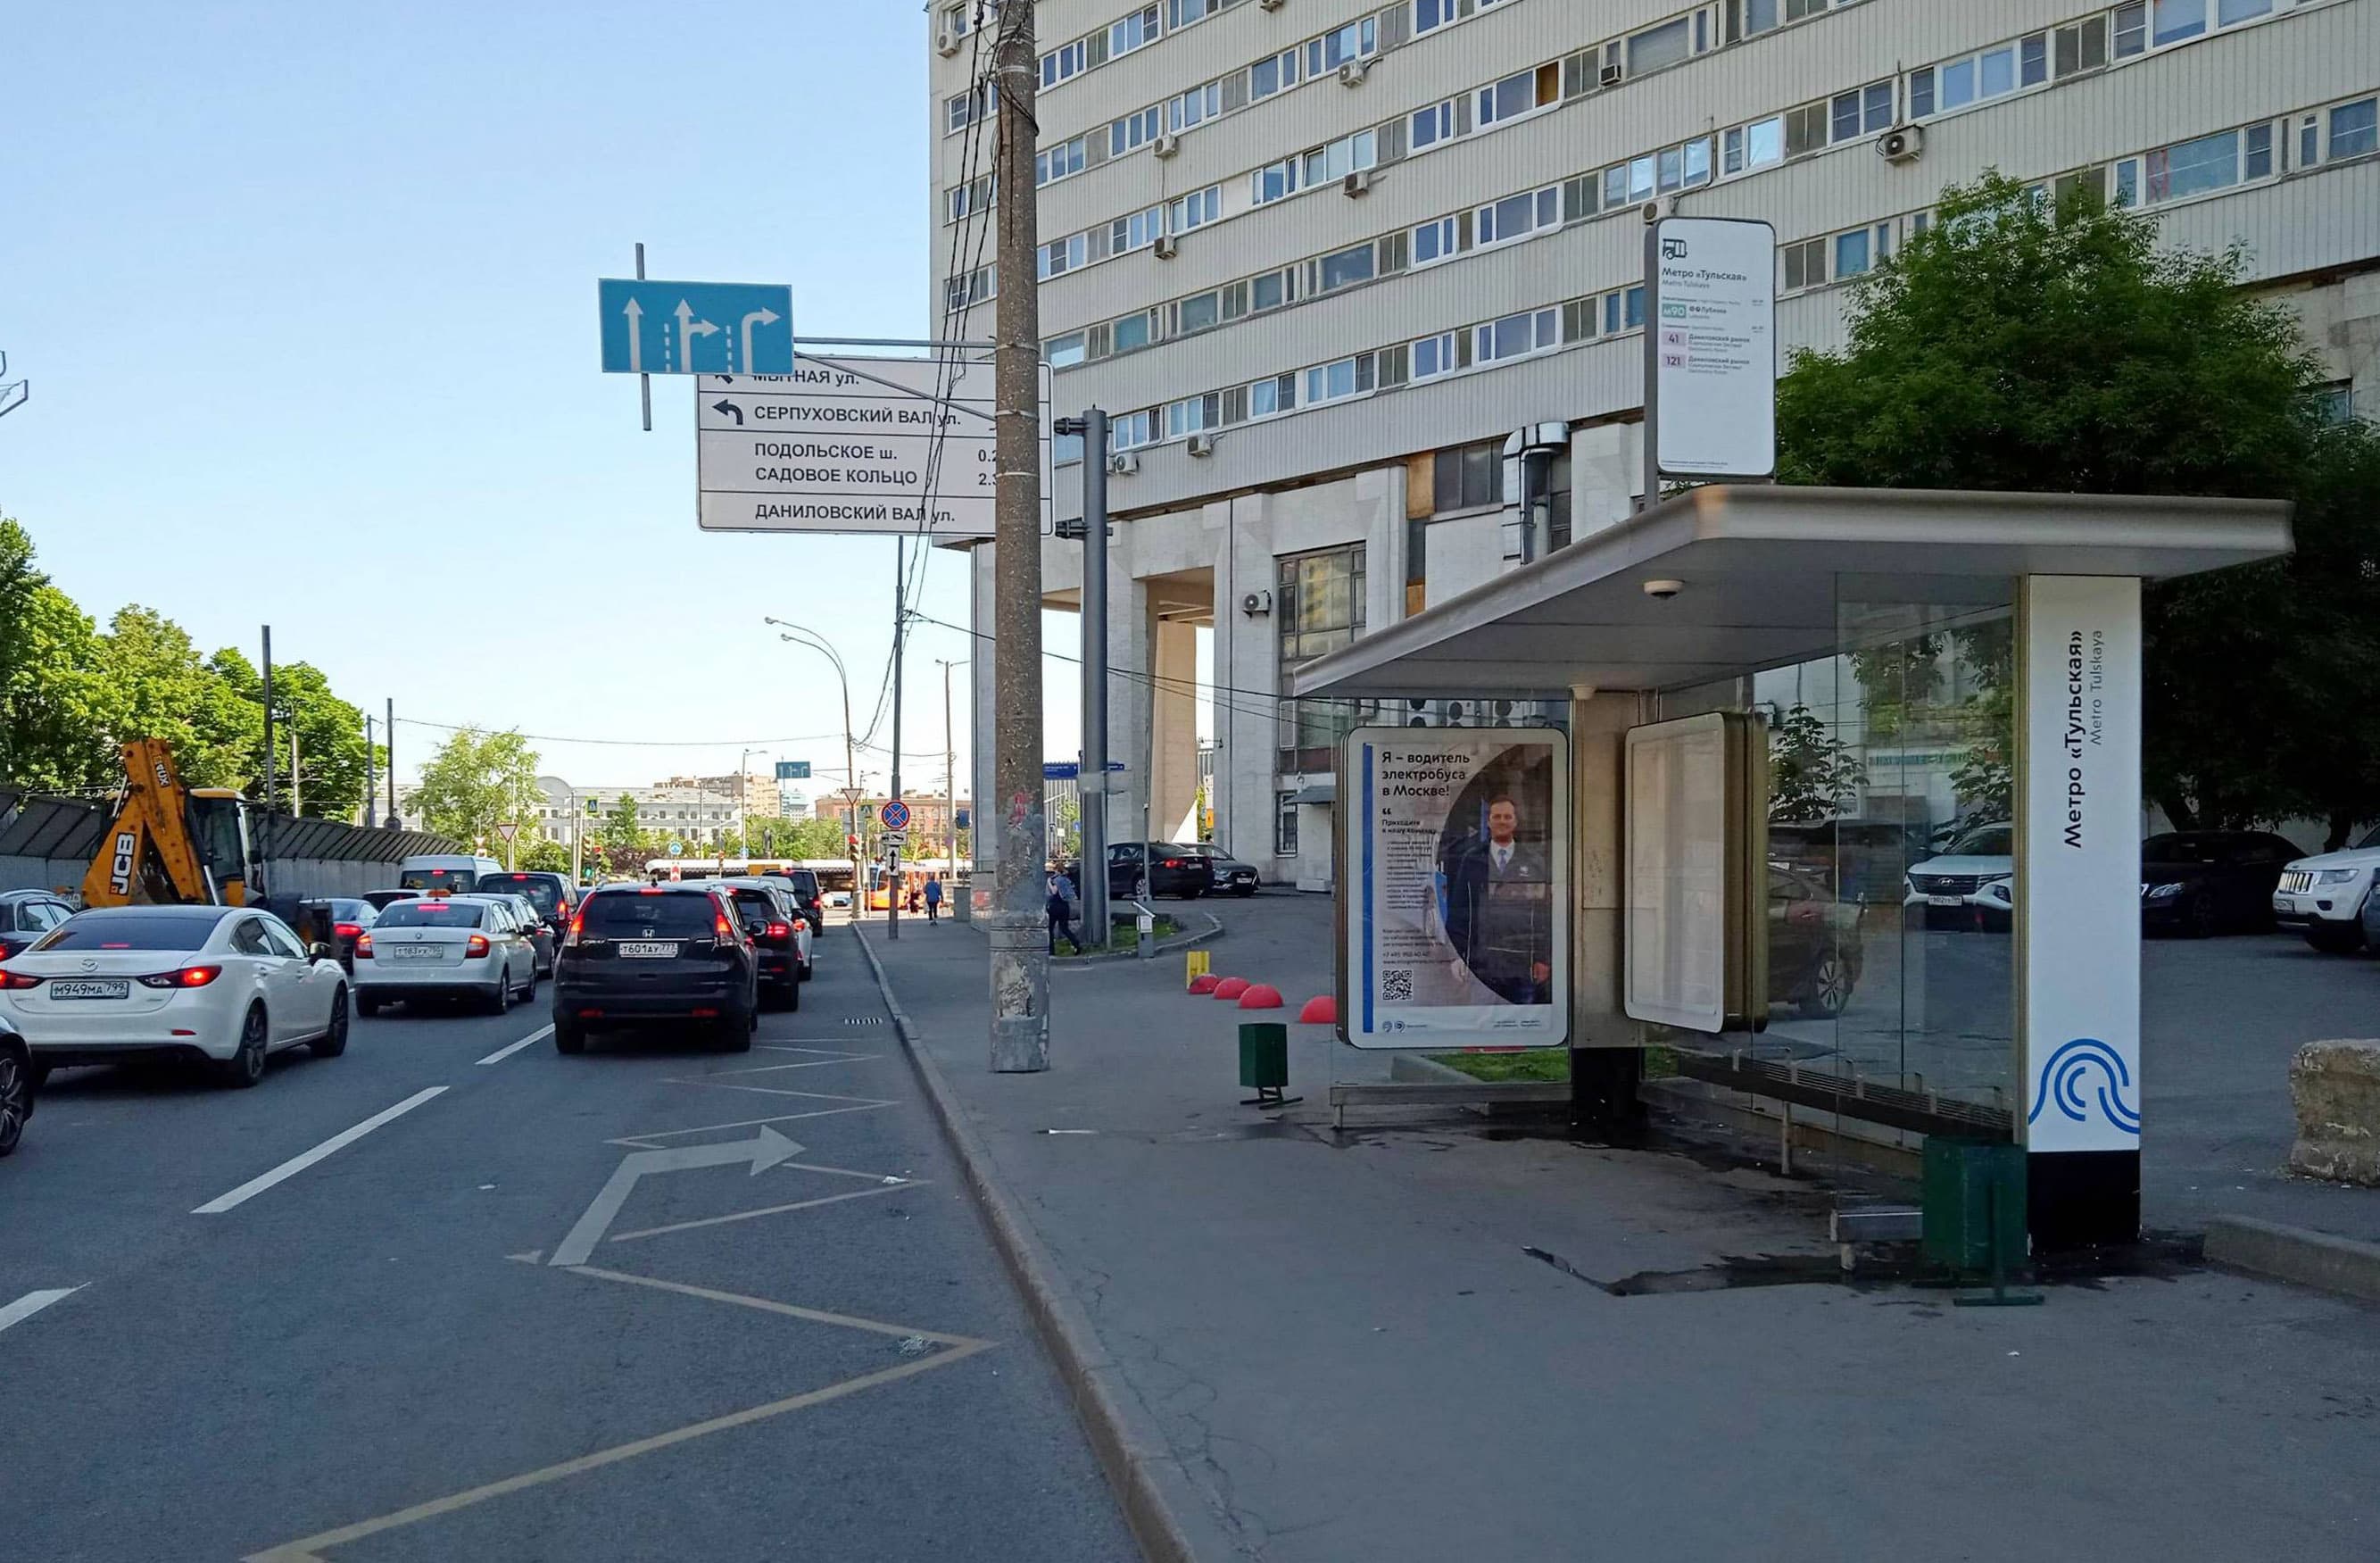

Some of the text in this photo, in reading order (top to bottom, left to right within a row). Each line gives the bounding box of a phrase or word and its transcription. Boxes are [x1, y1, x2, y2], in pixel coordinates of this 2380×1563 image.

[1662, 268, 1747, 281] Метро «Тульская»
[1669, 334, 1679, 344] 41
[1666, 356, 1680, 366] 121
[835, 373, 859, 387] ул.
[754, 406, 961, 428] СЕРПУХОВСКИЙ ВАЛ ул.
[754, 443, 875, 459] ПОДОЛЬСКОЕ
[879, 448, 898, 460] ш.
[755, 468, 842, 483] САДОВОЕ
[846, 470, 917, 486] КОЛЬЦО
[755, 503, 955, 524] ДАНИЛОВСКИЙ ВАЛ ул.
[2089, 630, 2104, 746] Metro Tulskaya
[2064, 630, 2086, 849] Метро «Тульская»
[1381, 752, 1391, 763] Я
[1407, 753, 1471, 765] водитель
[1381, 769, 1466, 782] электробуса
[1382, 785, 1449, 796] в Москве!
[112, 834, 135, 894] JCB
[106, 983, 124, 993] 799
